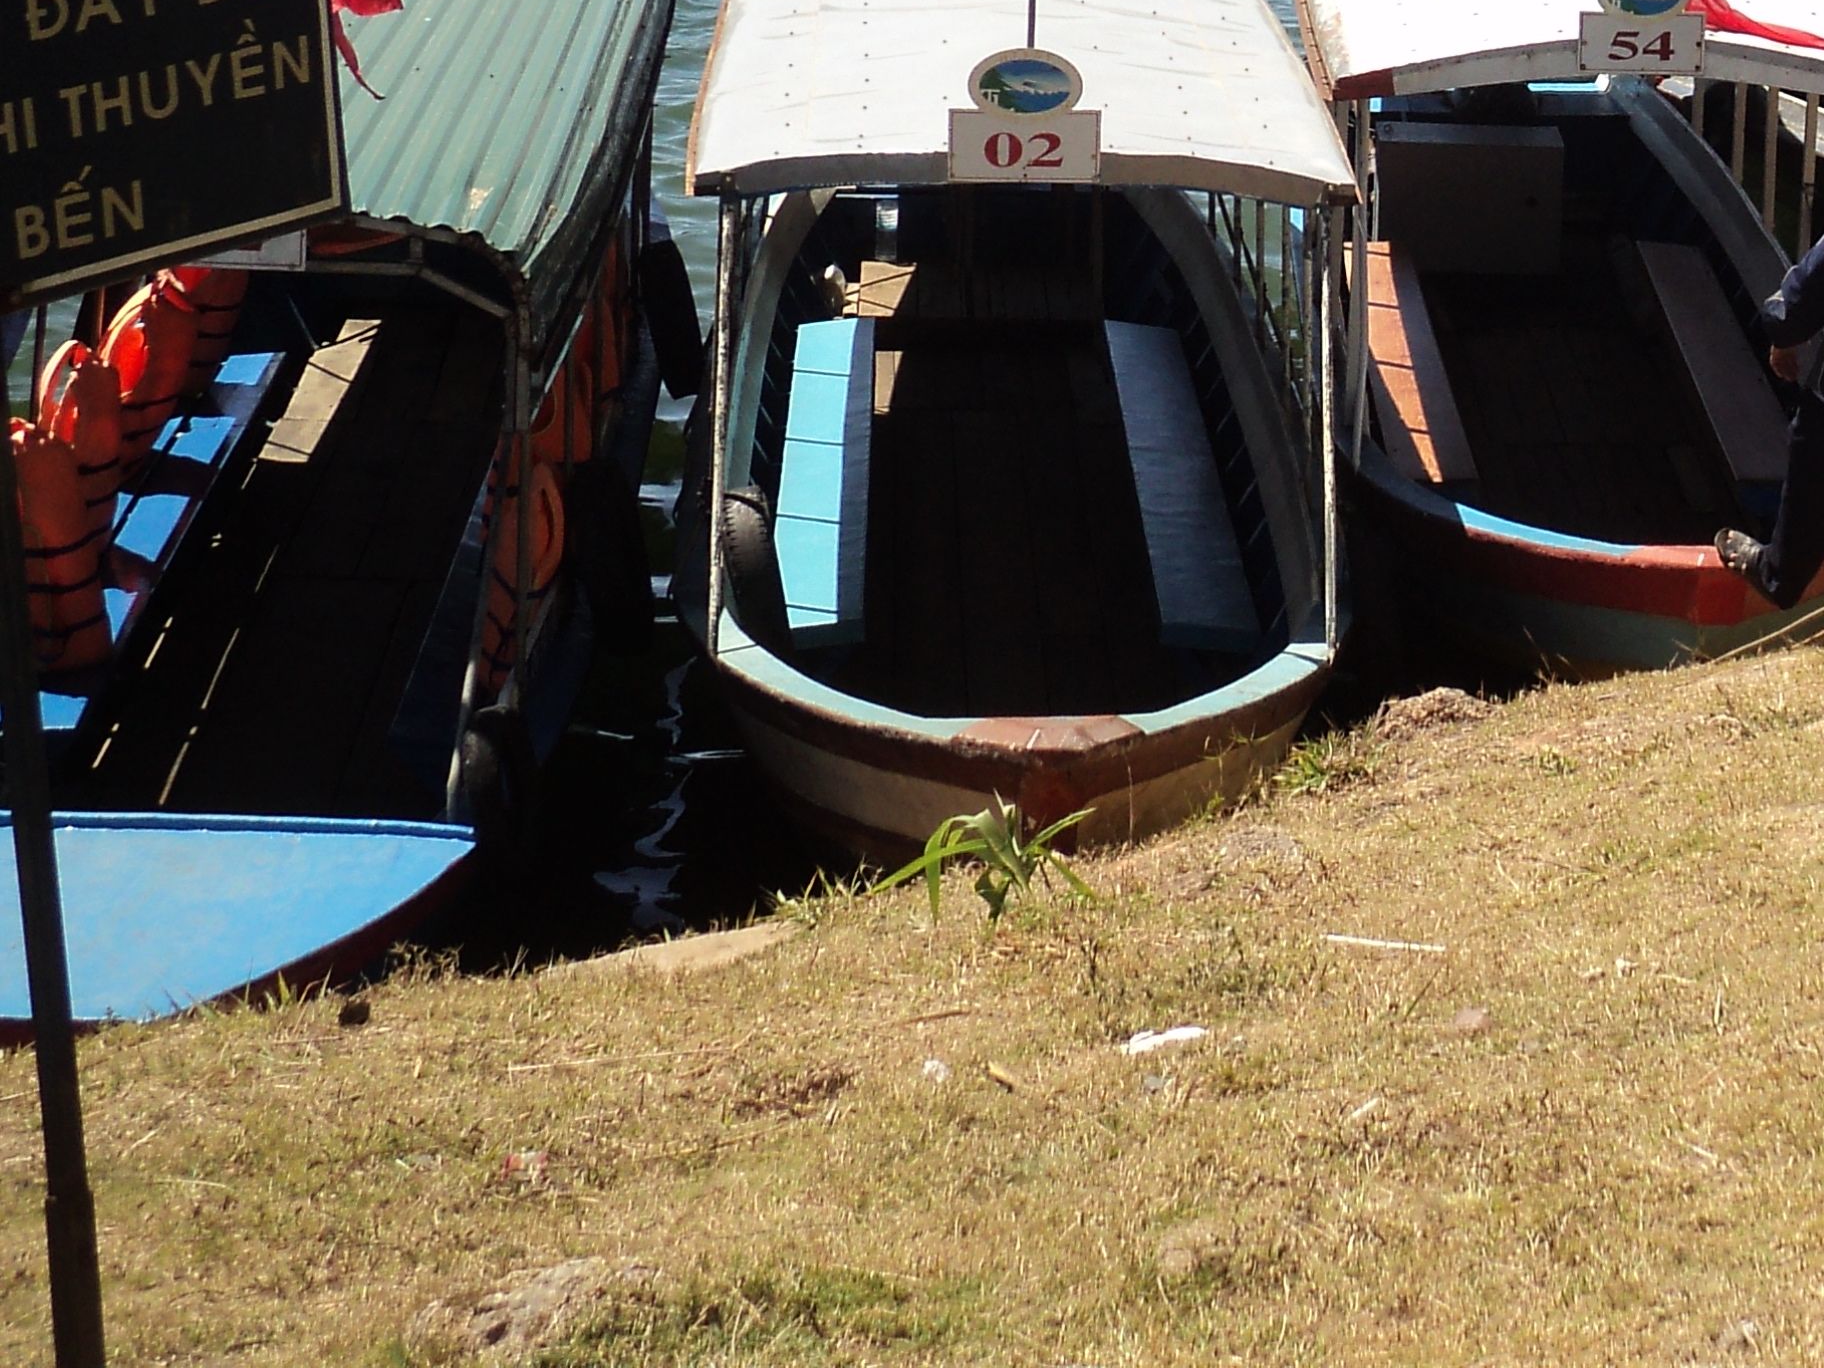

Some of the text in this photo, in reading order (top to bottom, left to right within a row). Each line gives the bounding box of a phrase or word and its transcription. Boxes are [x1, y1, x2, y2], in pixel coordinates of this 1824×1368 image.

[60, 18, 310, 137] THUYỀN
[1608, 31, 1675, 61] 54
[983, 132, 1064, 168] 02
[16, 166, 144, 259] BẾN
